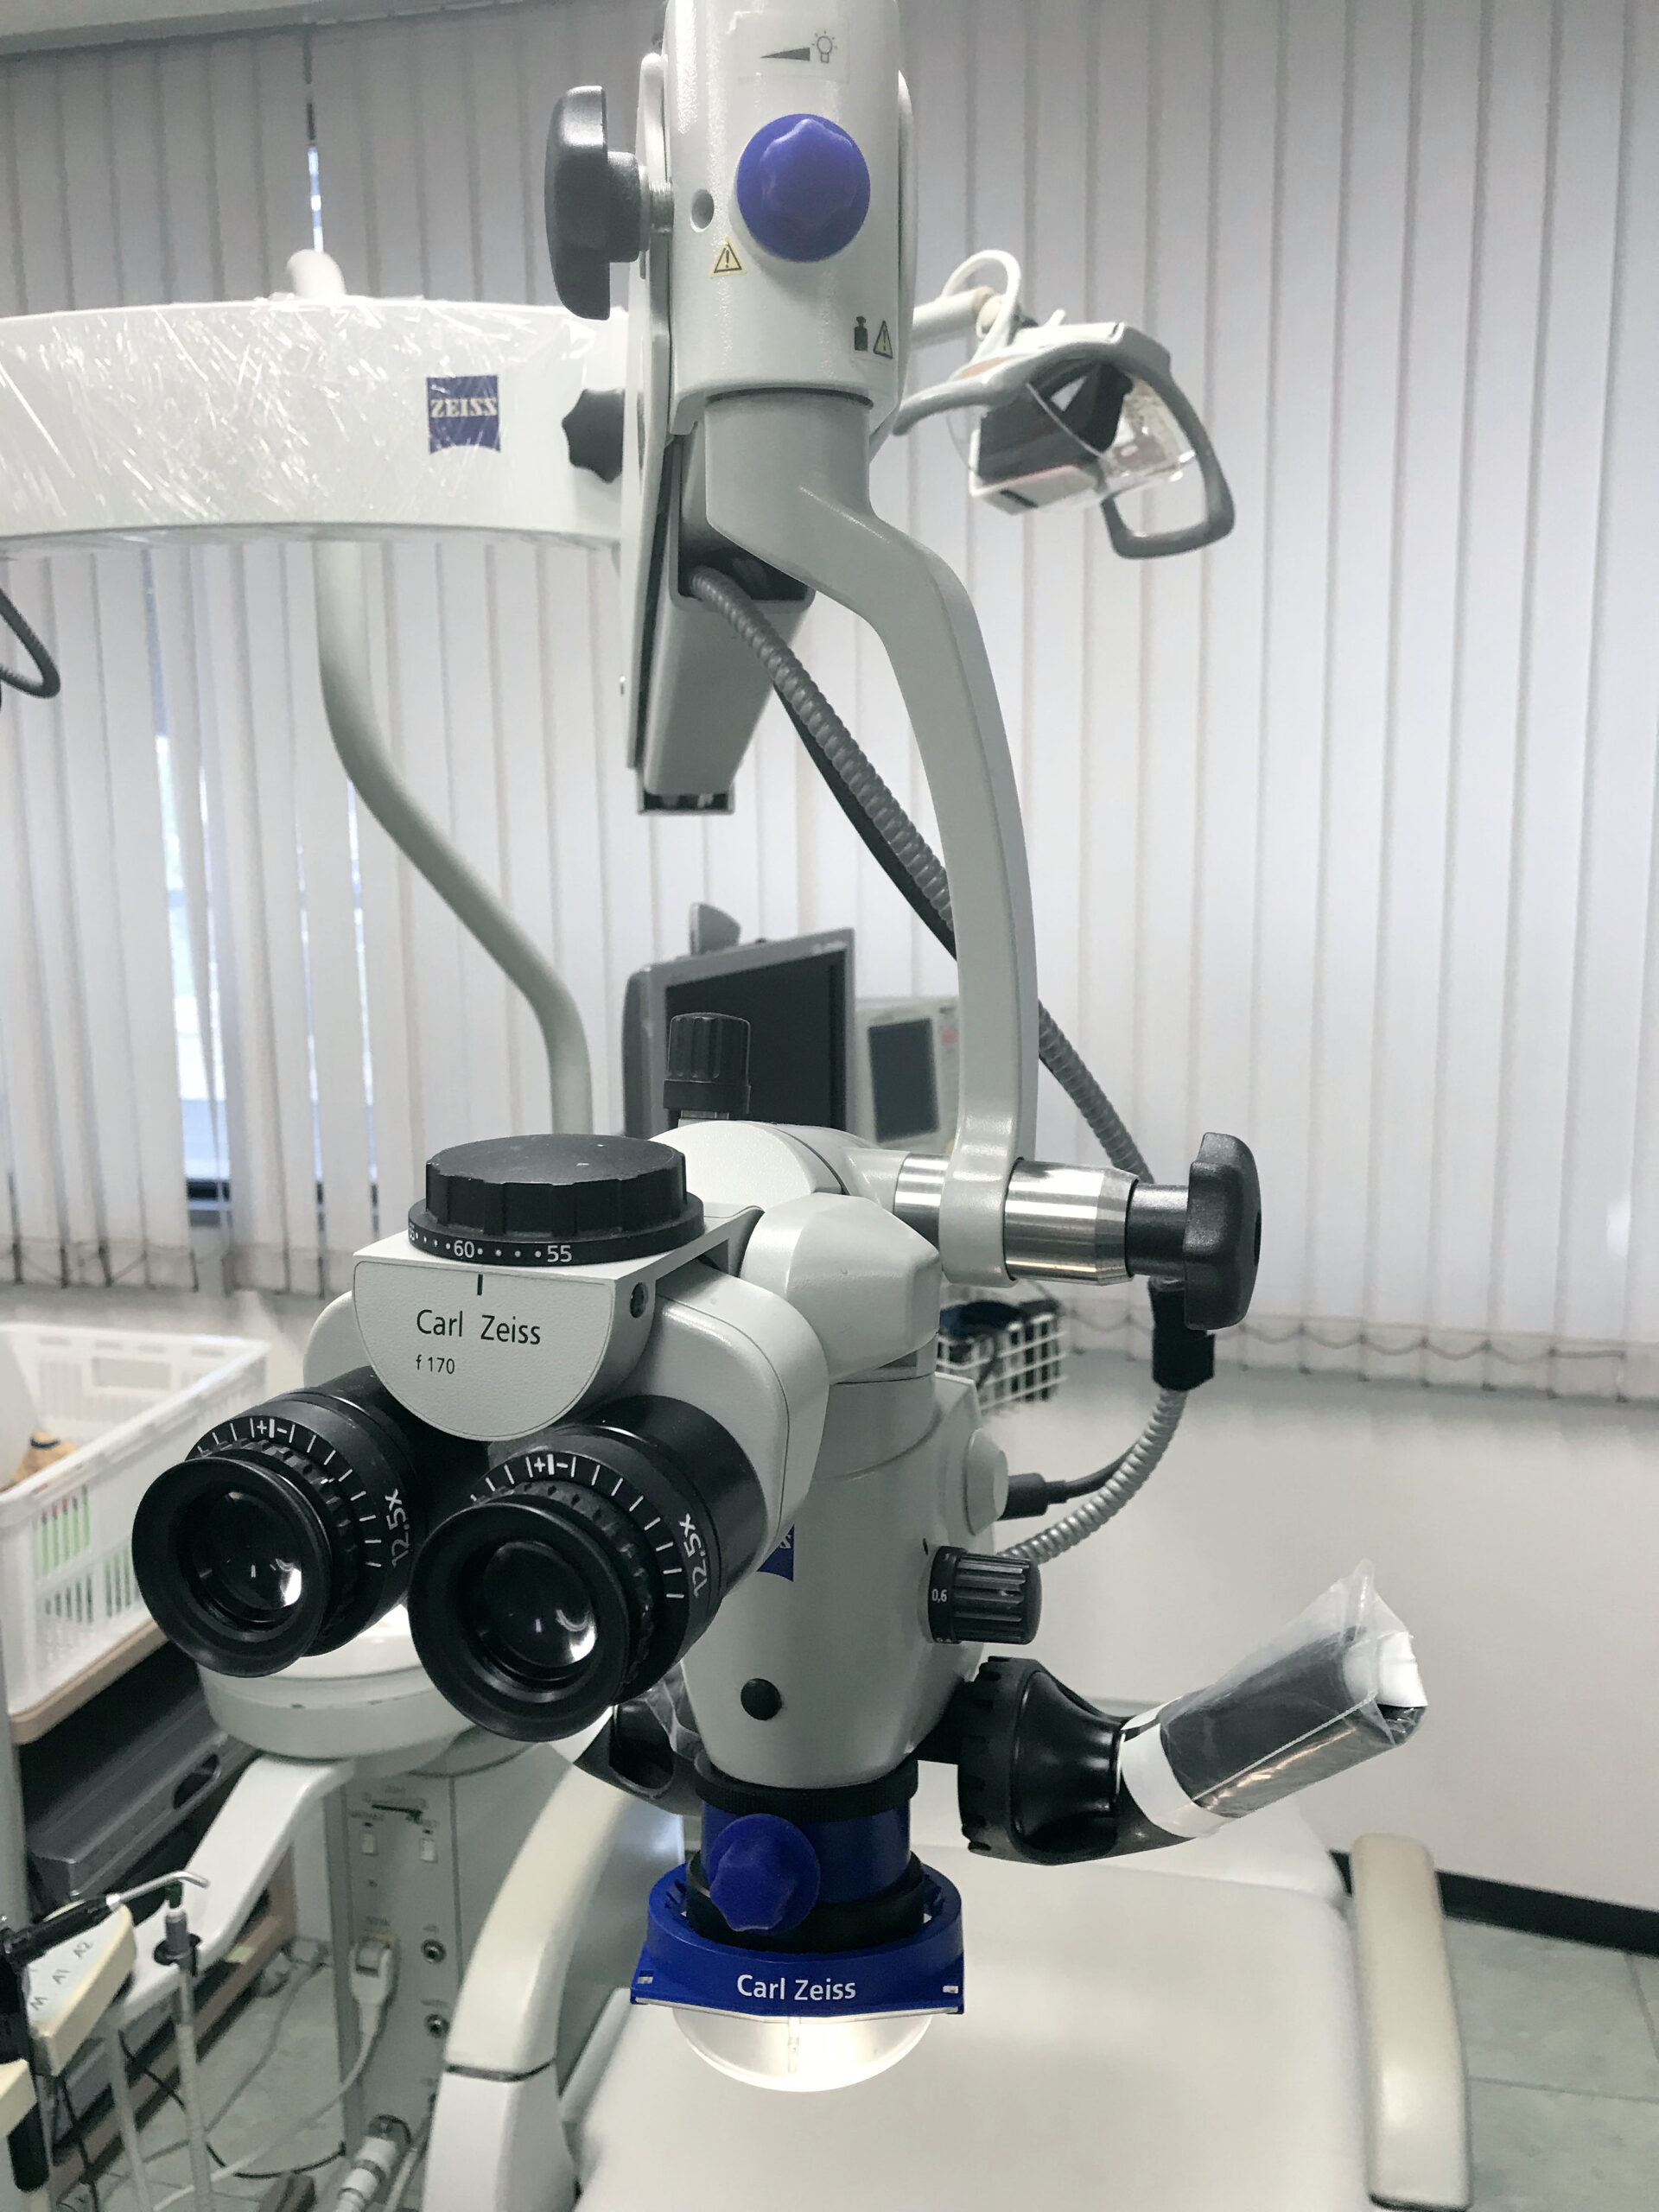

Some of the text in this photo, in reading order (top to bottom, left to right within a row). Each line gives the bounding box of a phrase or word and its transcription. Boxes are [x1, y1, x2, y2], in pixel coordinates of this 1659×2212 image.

[429, 397, 498, 417] ZEISS
[454, 1240, 475, 1258] 60
[547, 1245, 572, 1262] 55
[416, 1309, 541, 1345] Carl Zeiss
[428, 1357, 455, 1375] 170
[678, 1513, 708, 1598] 12.5x
[931, 1588, 948, 1603] 0,6
[737, 1974, 857, 2001] Carl Zeiss
